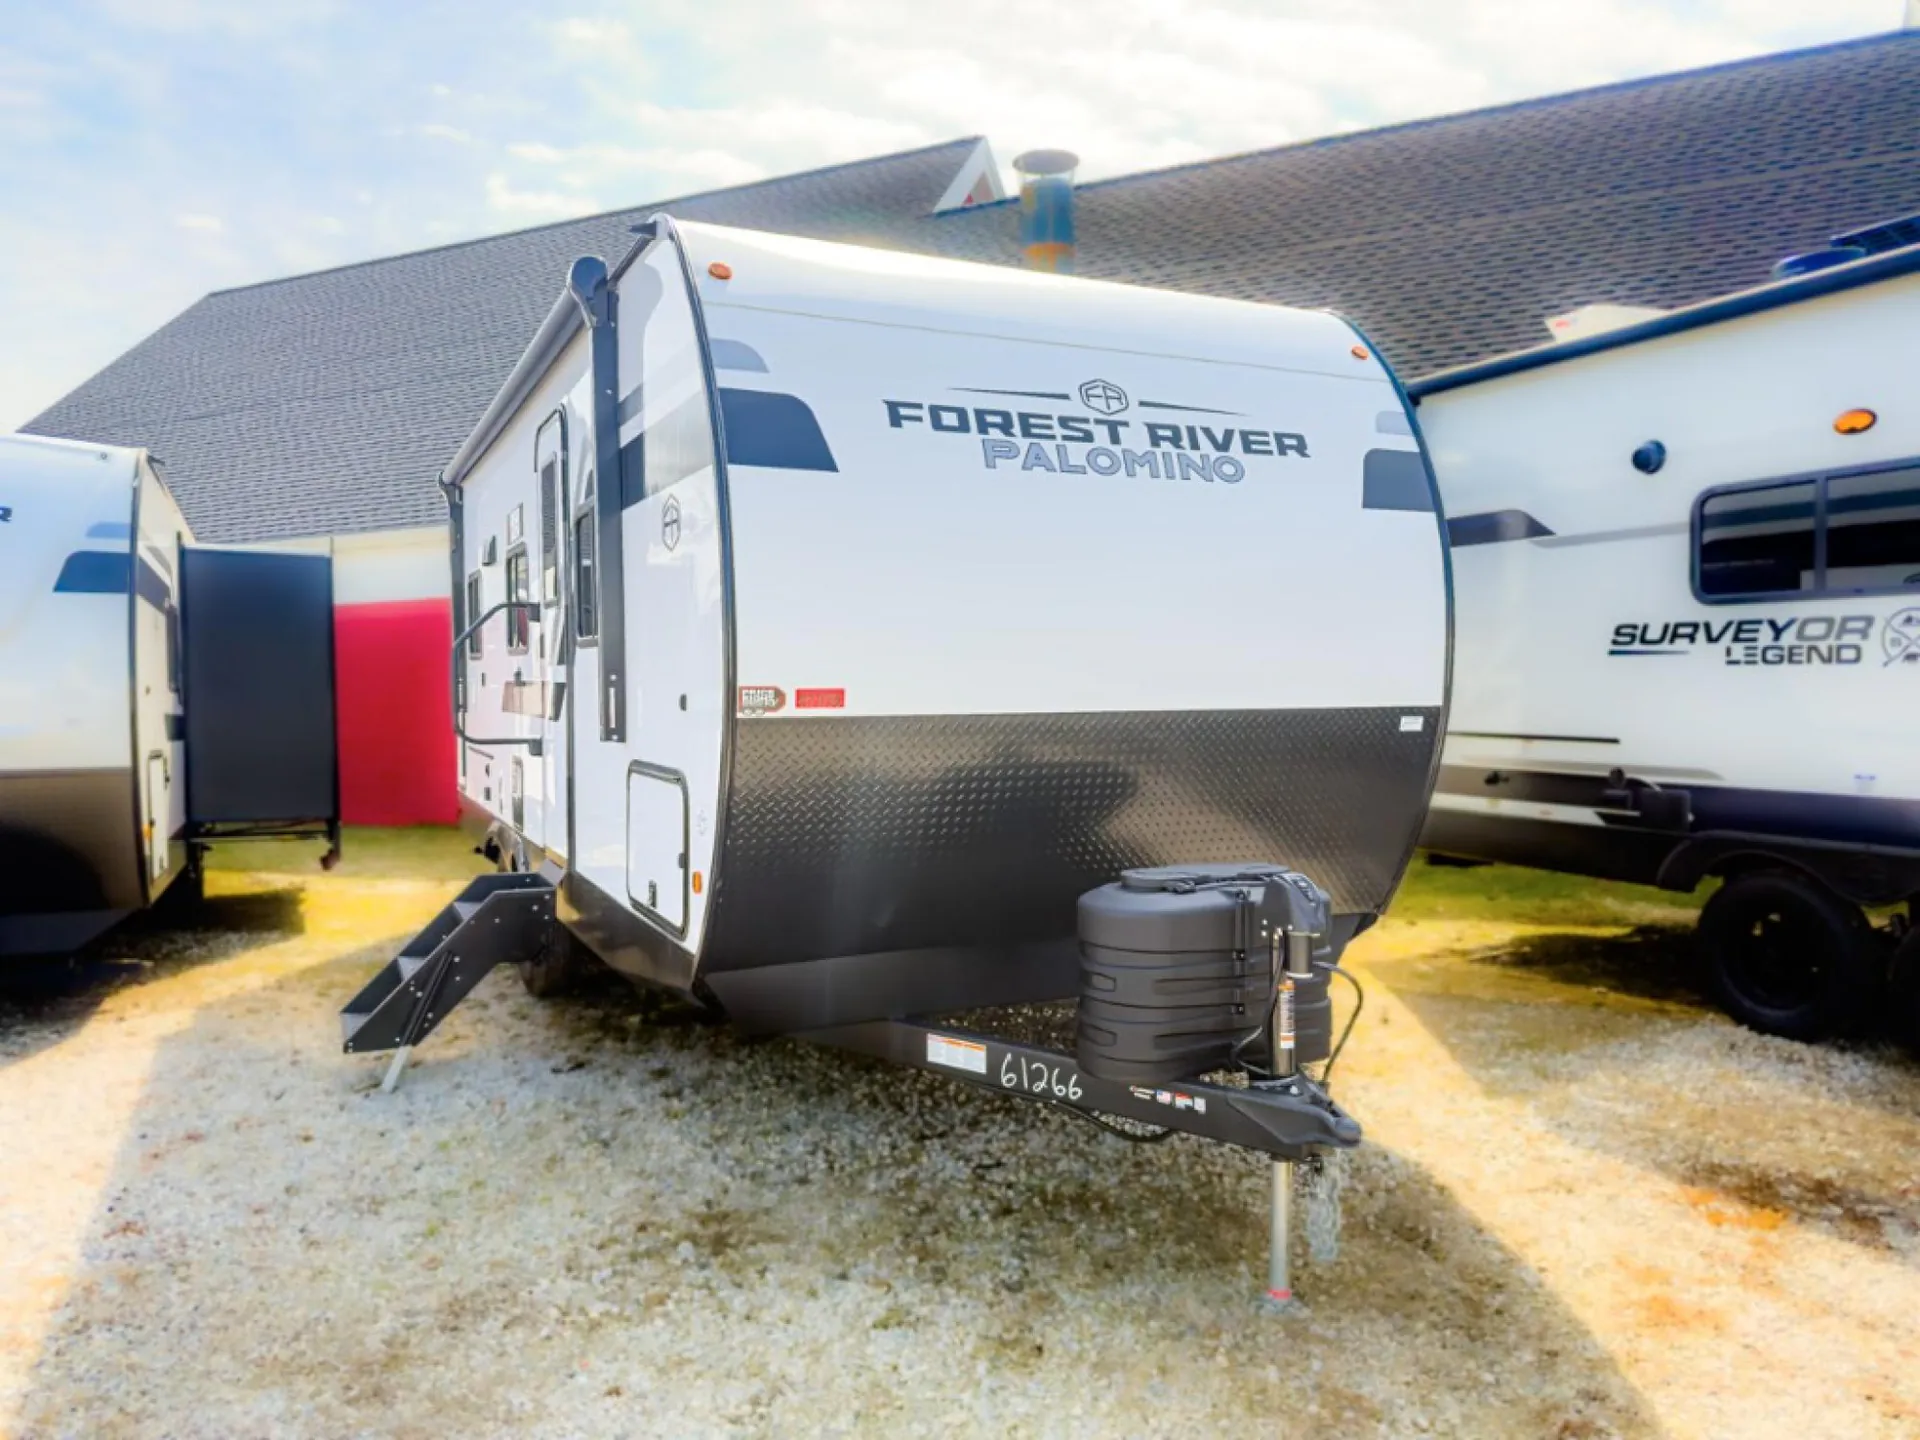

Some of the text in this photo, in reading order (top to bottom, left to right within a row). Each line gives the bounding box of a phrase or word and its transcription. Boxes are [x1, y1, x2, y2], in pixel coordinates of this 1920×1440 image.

[882, 400, 1311, 458] FOREST RIVER
[981, 438, 1246, 484] PALOMINO
[1610, 615, 1875, 646] SURVEYOR
[1725, 644, 1862, 665] LEGEND
[1000, 1052, 1083, 1100] 61266
